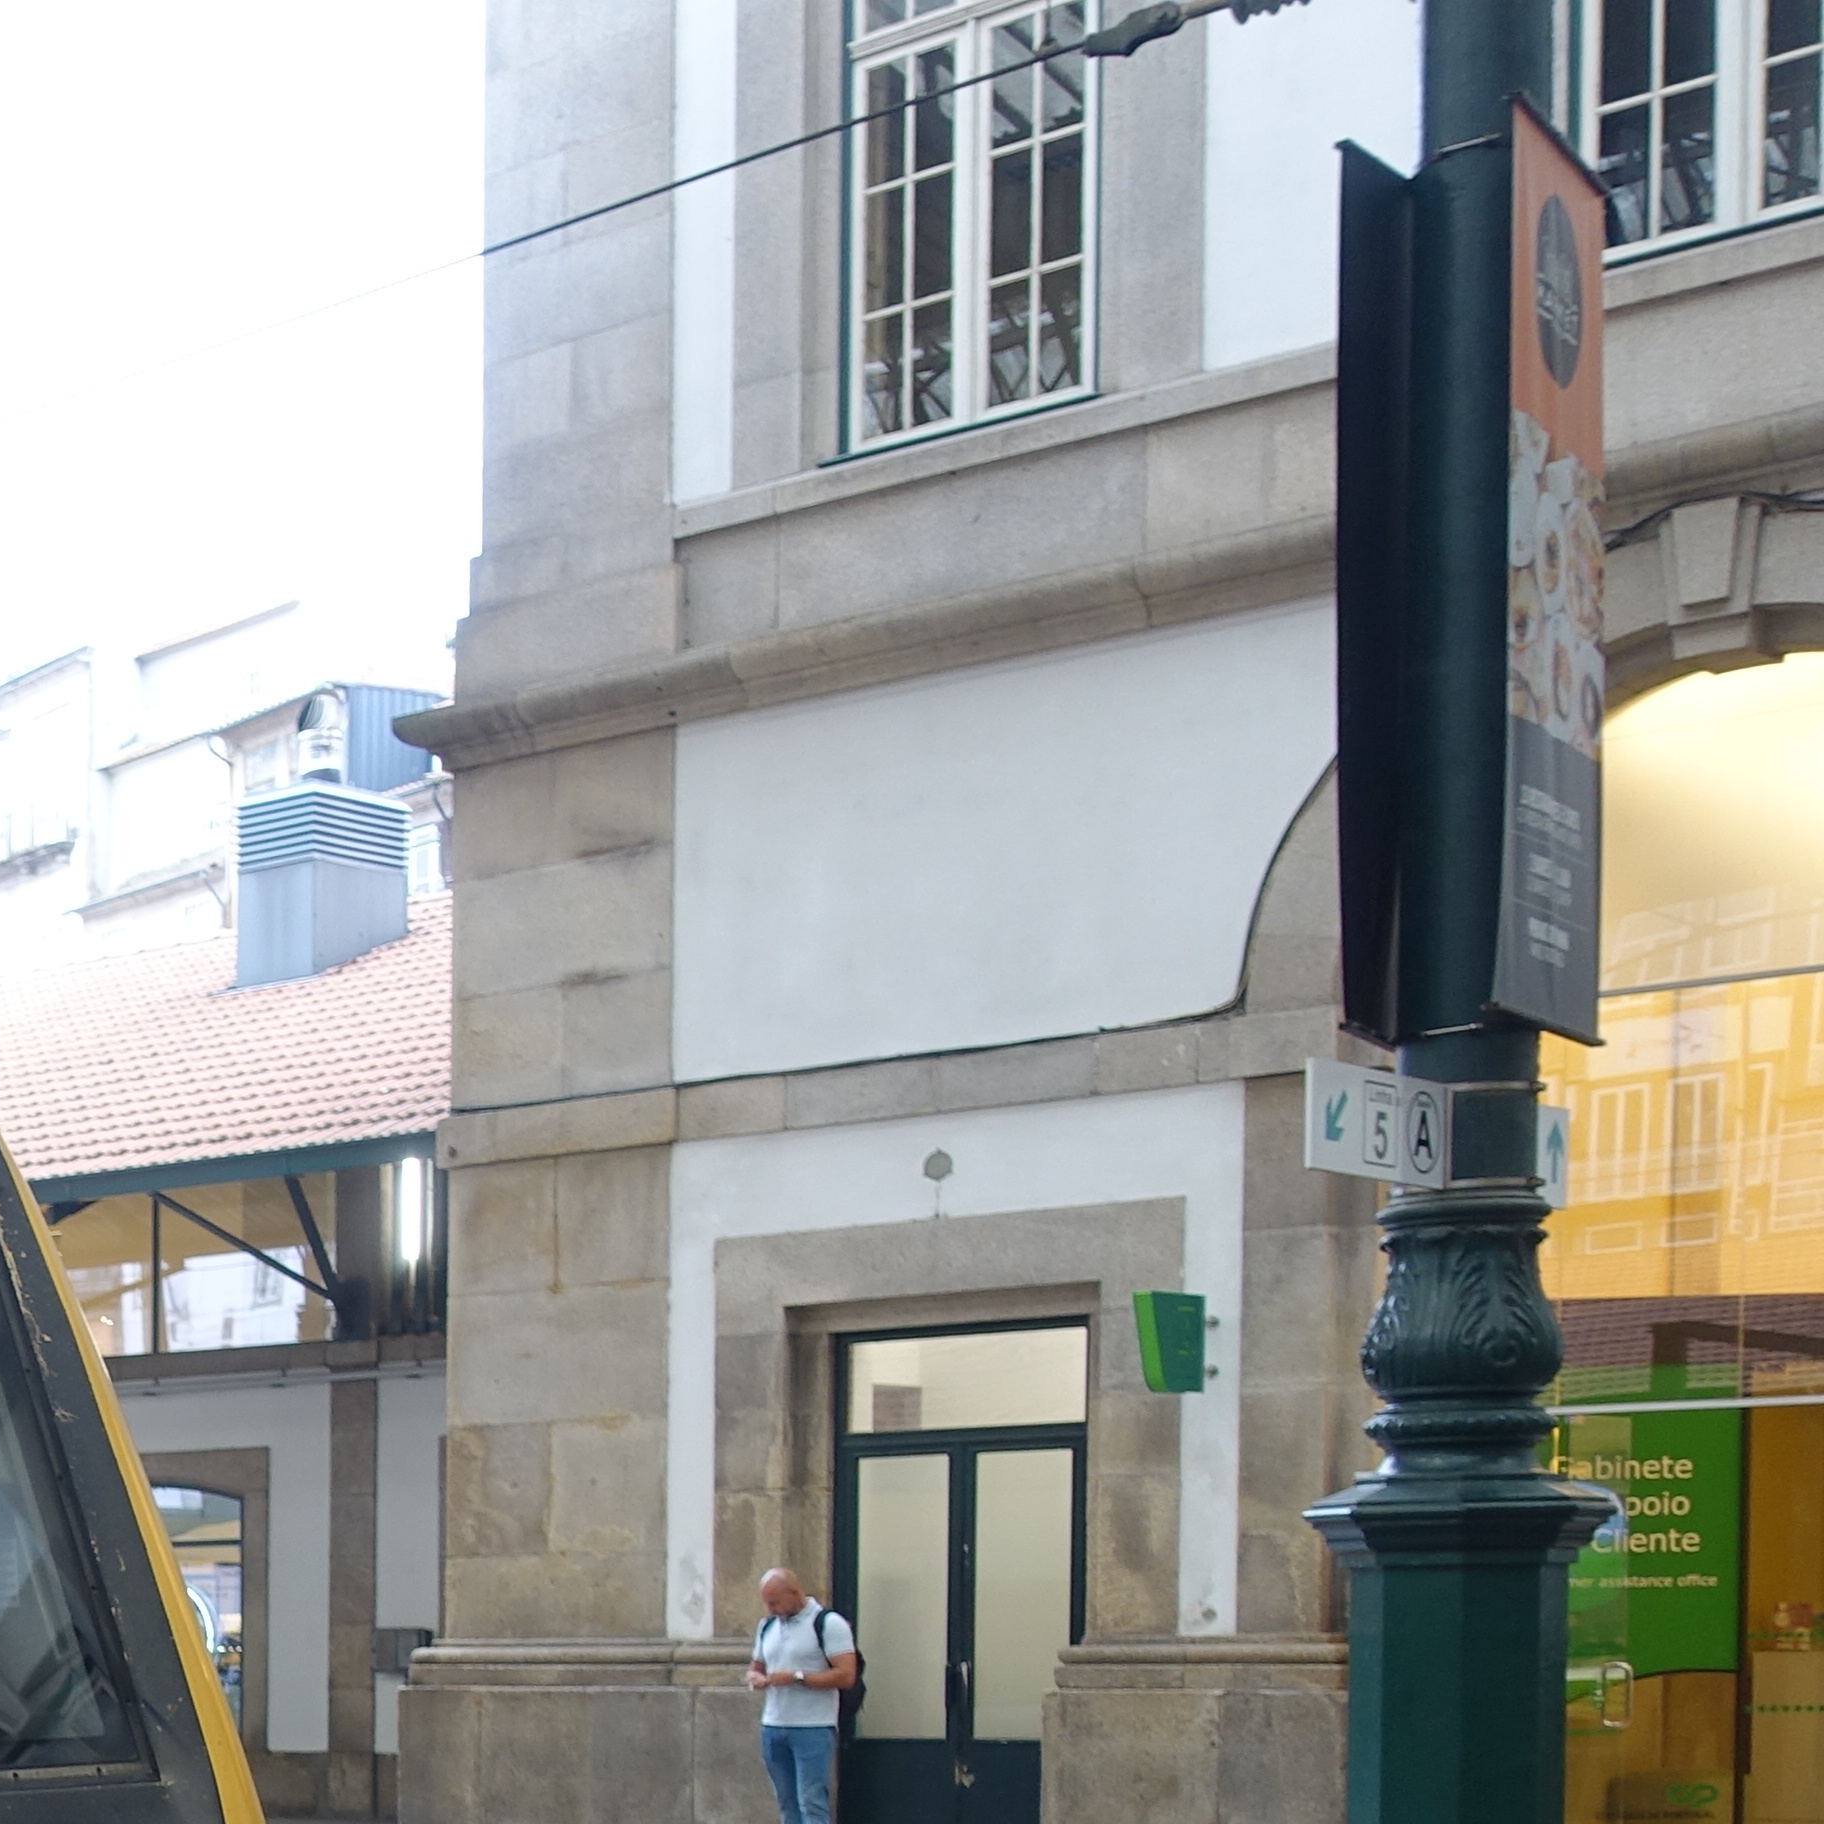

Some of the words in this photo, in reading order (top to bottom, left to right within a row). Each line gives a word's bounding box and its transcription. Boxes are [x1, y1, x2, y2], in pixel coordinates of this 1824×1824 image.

[1373, 1110, 1388, 1160] 5
[1414, 1110, 1433, 1160] A
[1625, 1491, 1691, 1517] poio
[1591, 1528, 1702, 1554] Cliente
[1598, 1574, 1674, 1588] assistance
[1676, 1573, 1719, 1588] office
